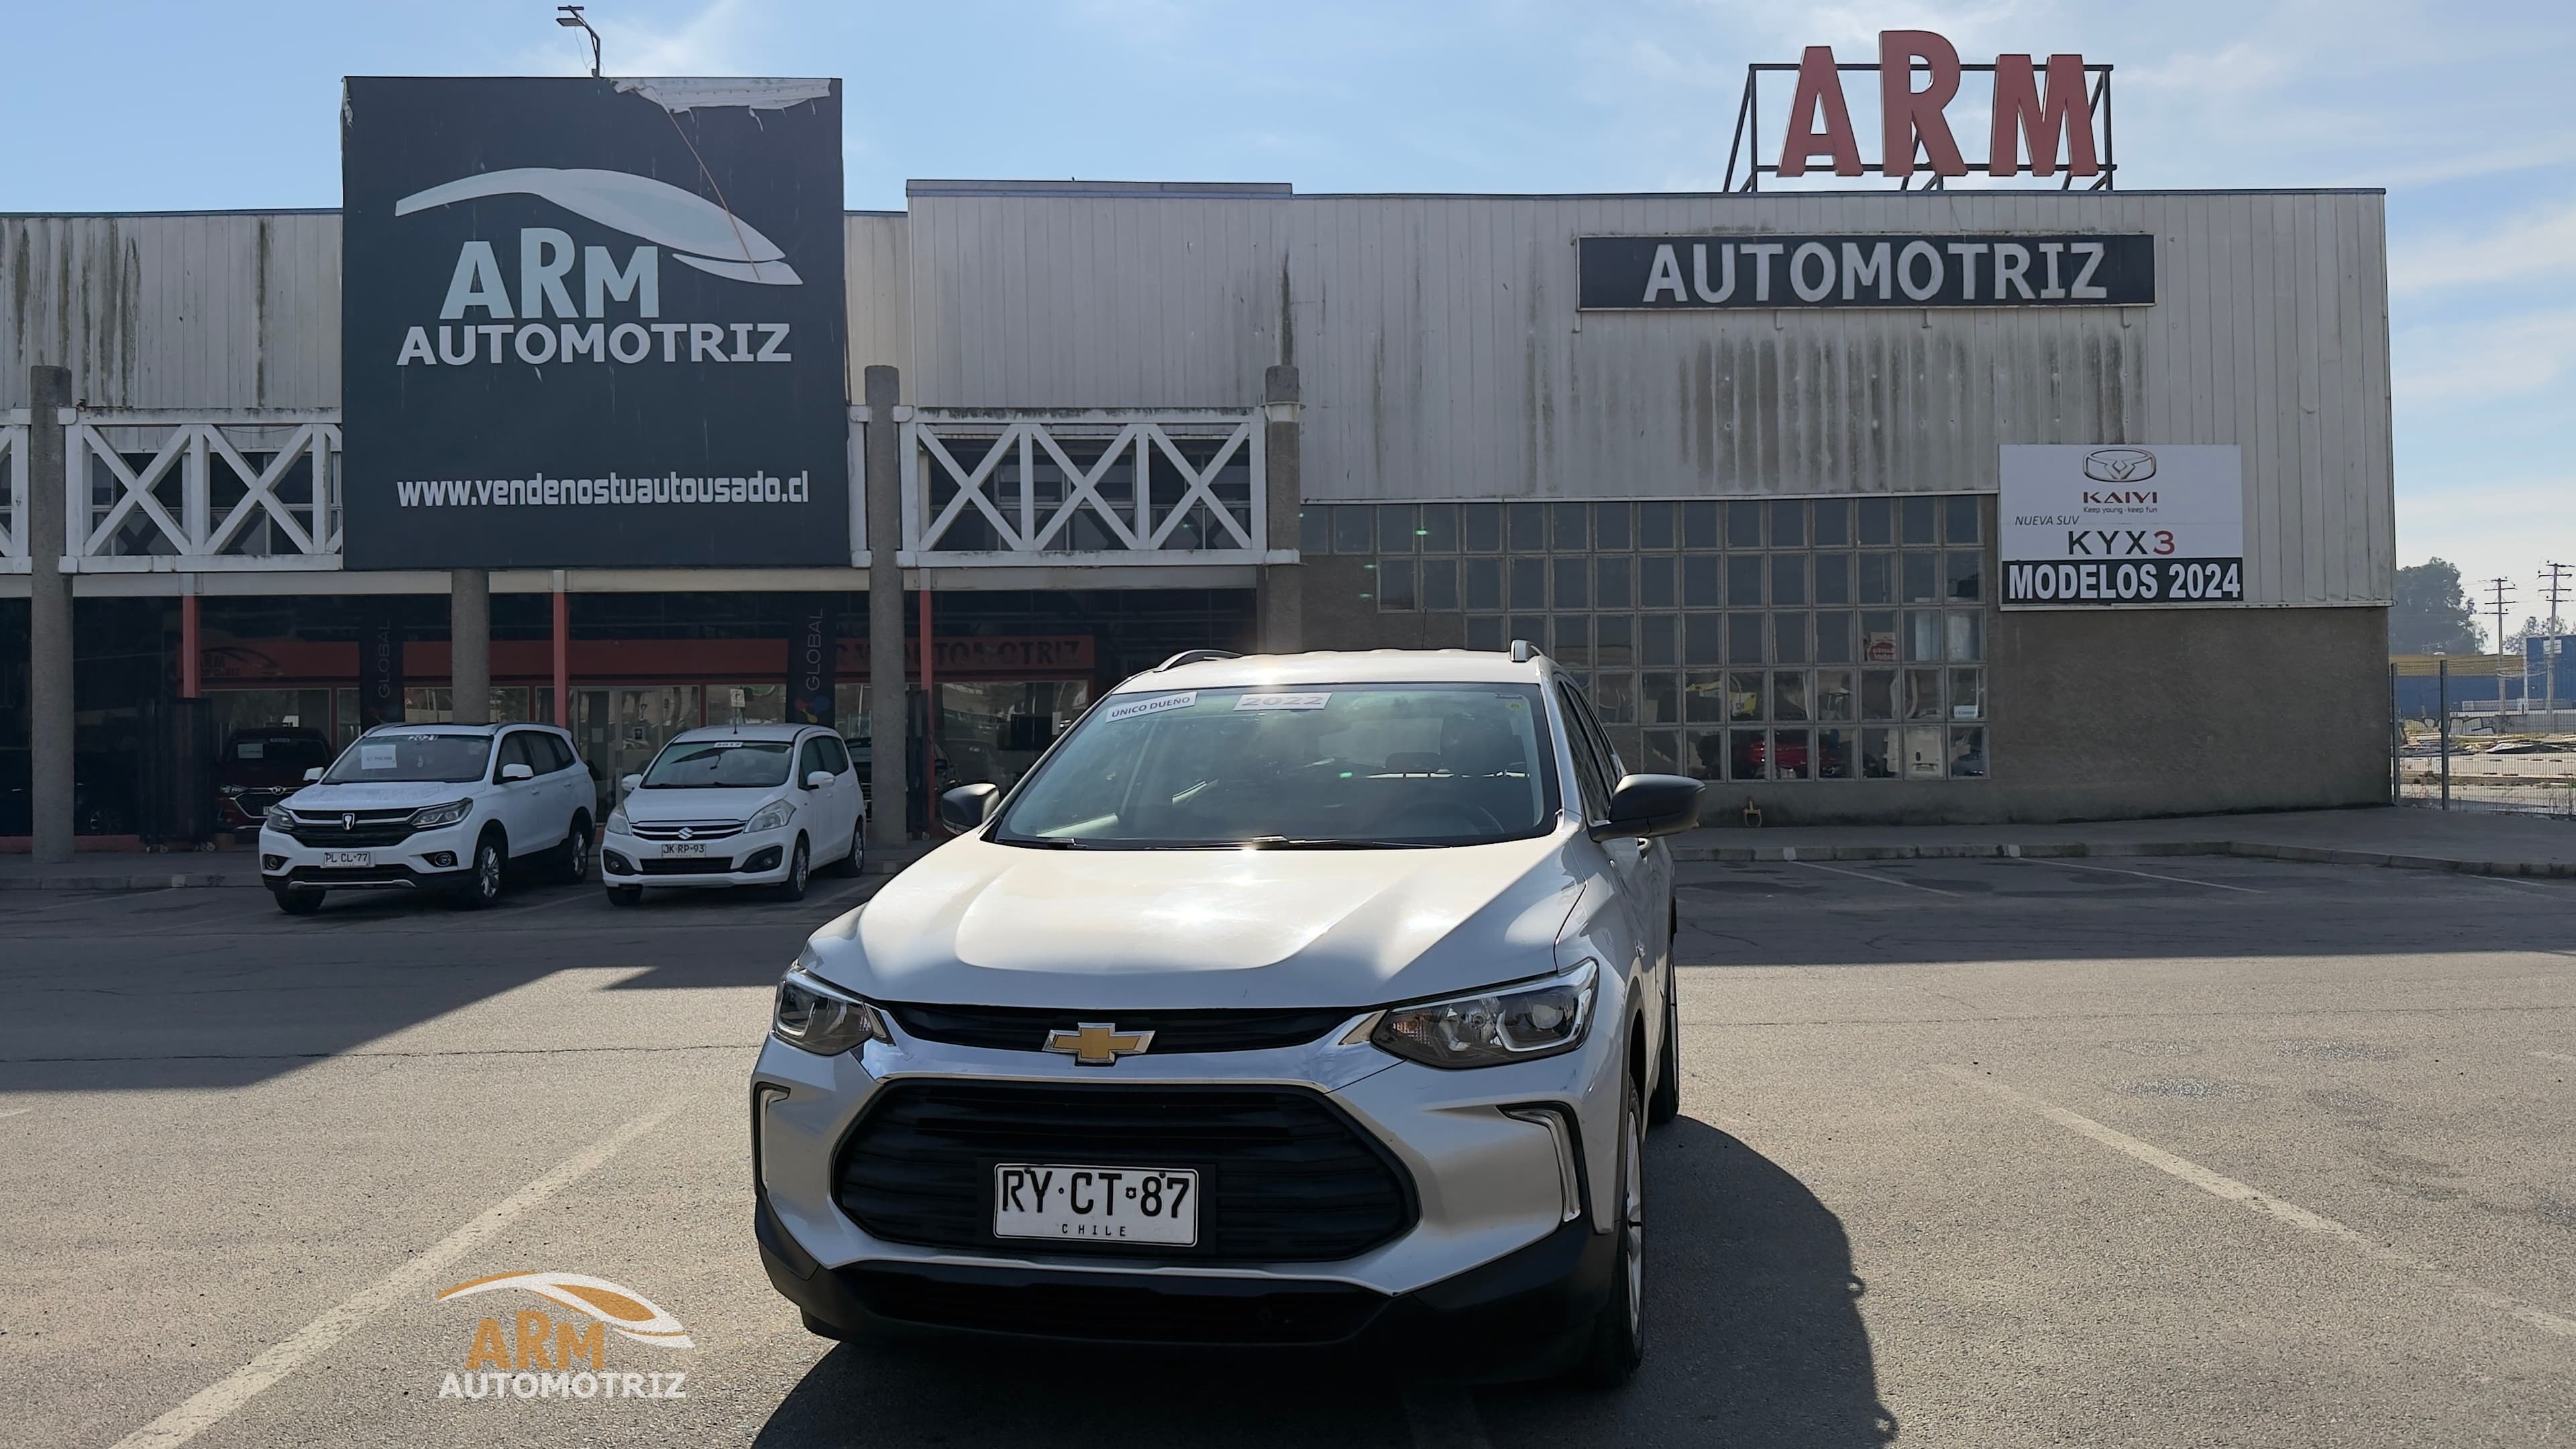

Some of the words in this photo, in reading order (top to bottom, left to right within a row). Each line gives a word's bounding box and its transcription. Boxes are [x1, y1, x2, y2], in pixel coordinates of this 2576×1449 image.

[1776, 30, 2099, 178] ARM
[439, 227, 660, 319] ARM
[1643, 240, 2108, 304] AUTOMOTRIZ
[396, 323, 792, 366] AUTOMOTRIZ
[397, 470, 809, 507] www.vendenostuautousado.cl
[2015, 515, 2053, 526] NUEVA
[2055, 515, 2080, 526] SUV
[2083, 506, 2101, 514] Keep
[2127, 506, 2144, 514] keep
[2068, 530, 2176, 555] KYX3
[2008, 563, 2158, 600] MODELOS
[2168, 563, 2241, 598] 2024
[378, 619, 390, 698] GLOBAL
[806, 607, 823, 691] GLOBAL
[1111, 704, 1147, 718] ÚNICO
[1149, 696, 1191, 710] DUEÑO
[1242, 696, 1324, 706] 2022
[1061, 1223, 1126, 1237] CHILE
